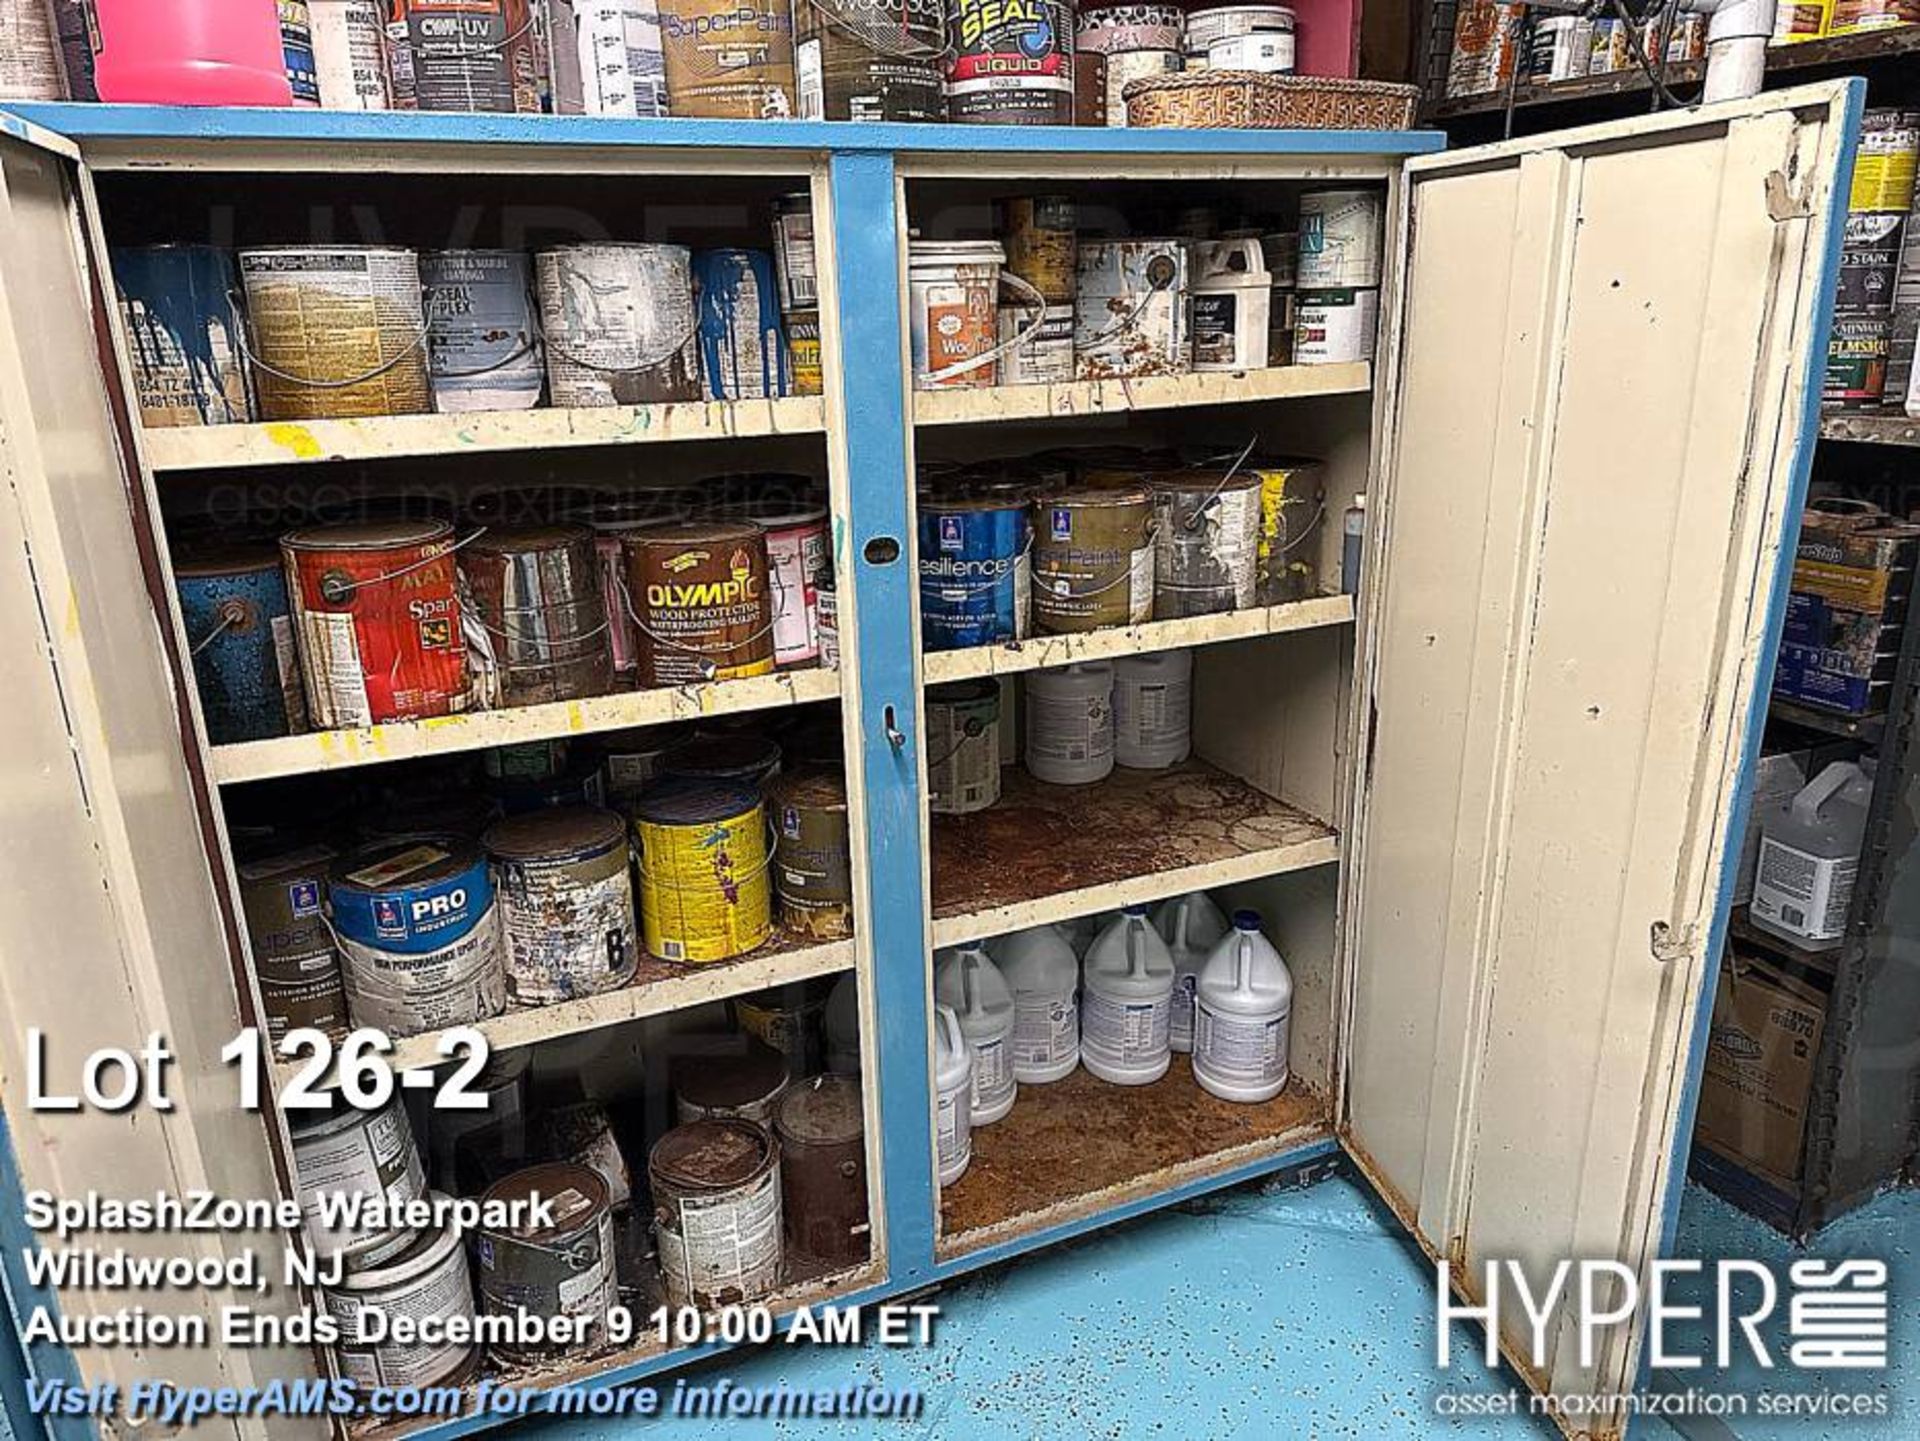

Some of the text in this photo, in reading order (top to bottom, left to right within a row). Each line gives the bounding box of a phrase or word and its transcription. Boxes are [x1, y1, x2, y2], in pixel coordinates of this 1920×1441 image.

[962, 0, 1043, 48] SEAL
[974, 59, 1042, 73] LIQUID
[920, 557, 1008, 577] esilience
[647, 576, 759, 607] OLYMPIC
[650, 602, 760, 620] WOOD PROTECTOR
[411, 889, 467, 921] PRO
[606, 927, 624, 972] B
